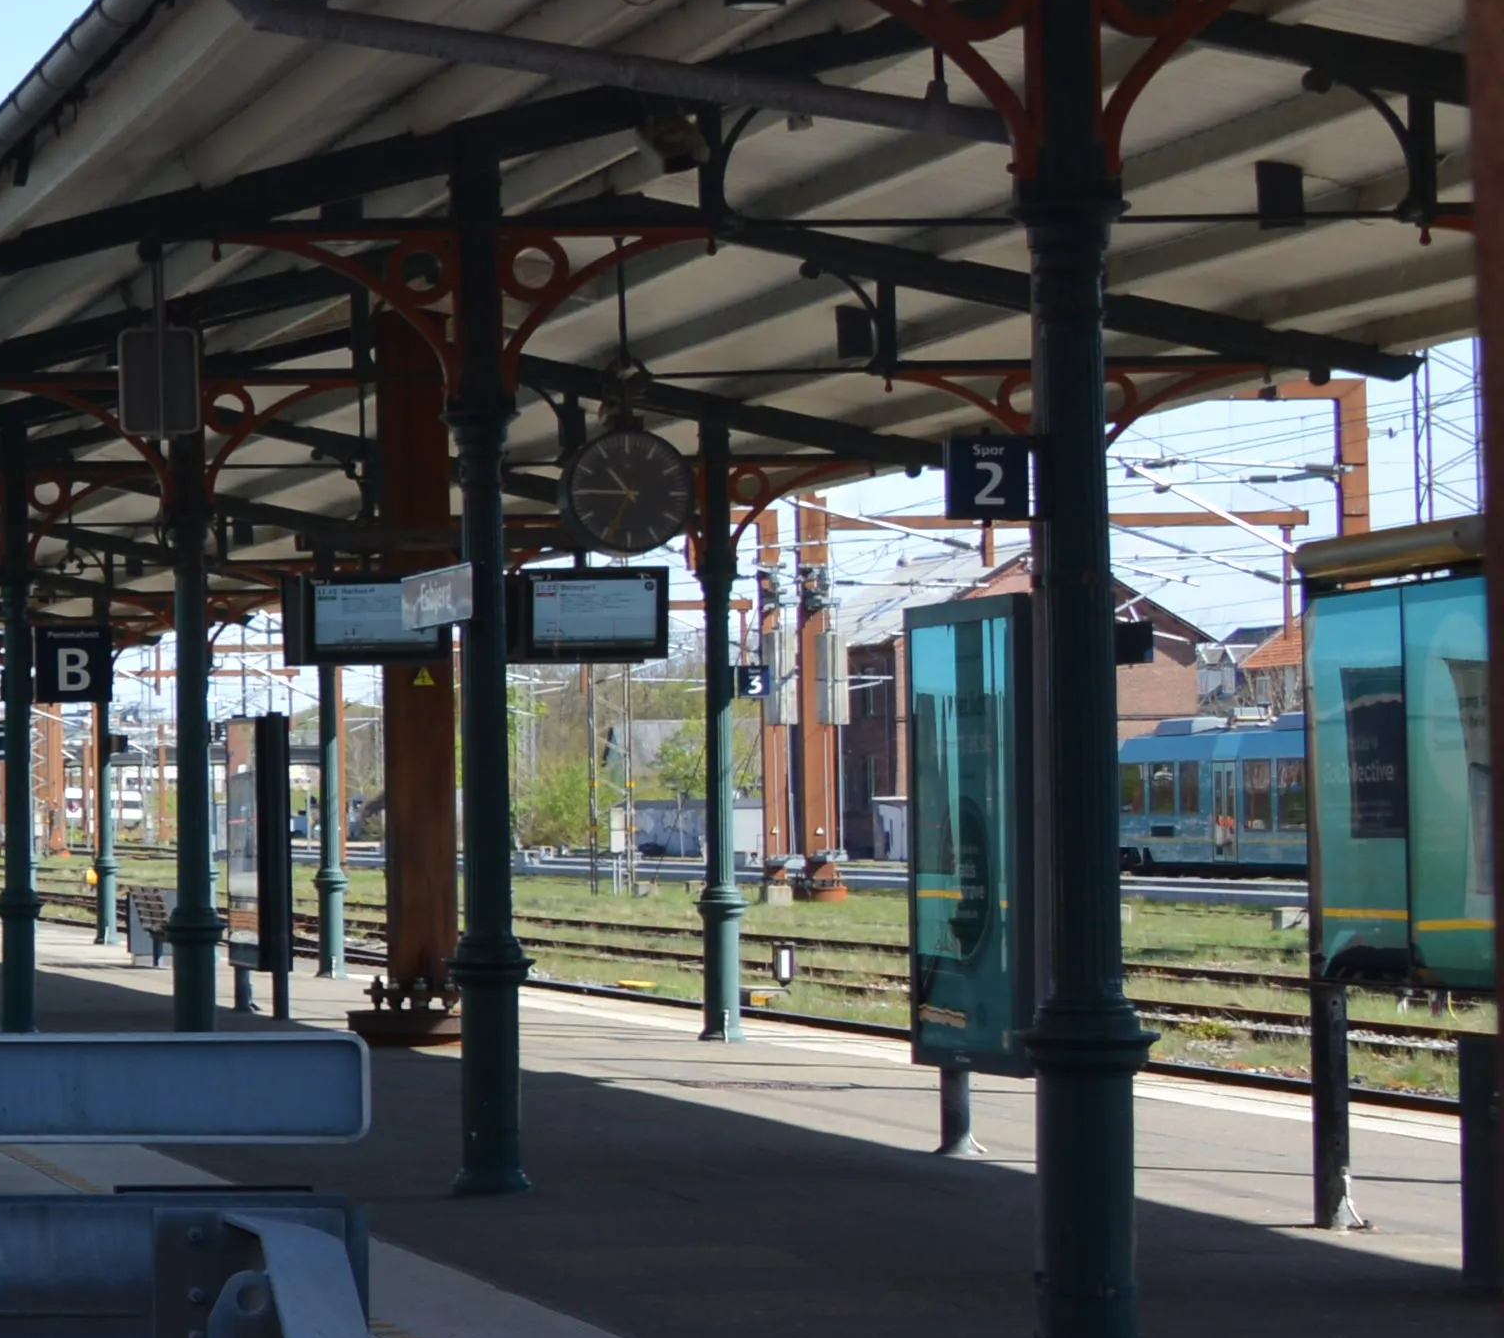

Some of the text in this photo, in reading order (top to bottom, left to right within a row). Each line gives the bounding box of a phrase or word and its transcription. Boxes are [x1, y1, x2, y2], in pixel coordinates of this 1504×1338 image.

[972, 443, 1005, 458] Spor
[974, 461, 1006, 505] 2
[57, 648, 91, 692] B
[748, 675, 763, 694] 3
